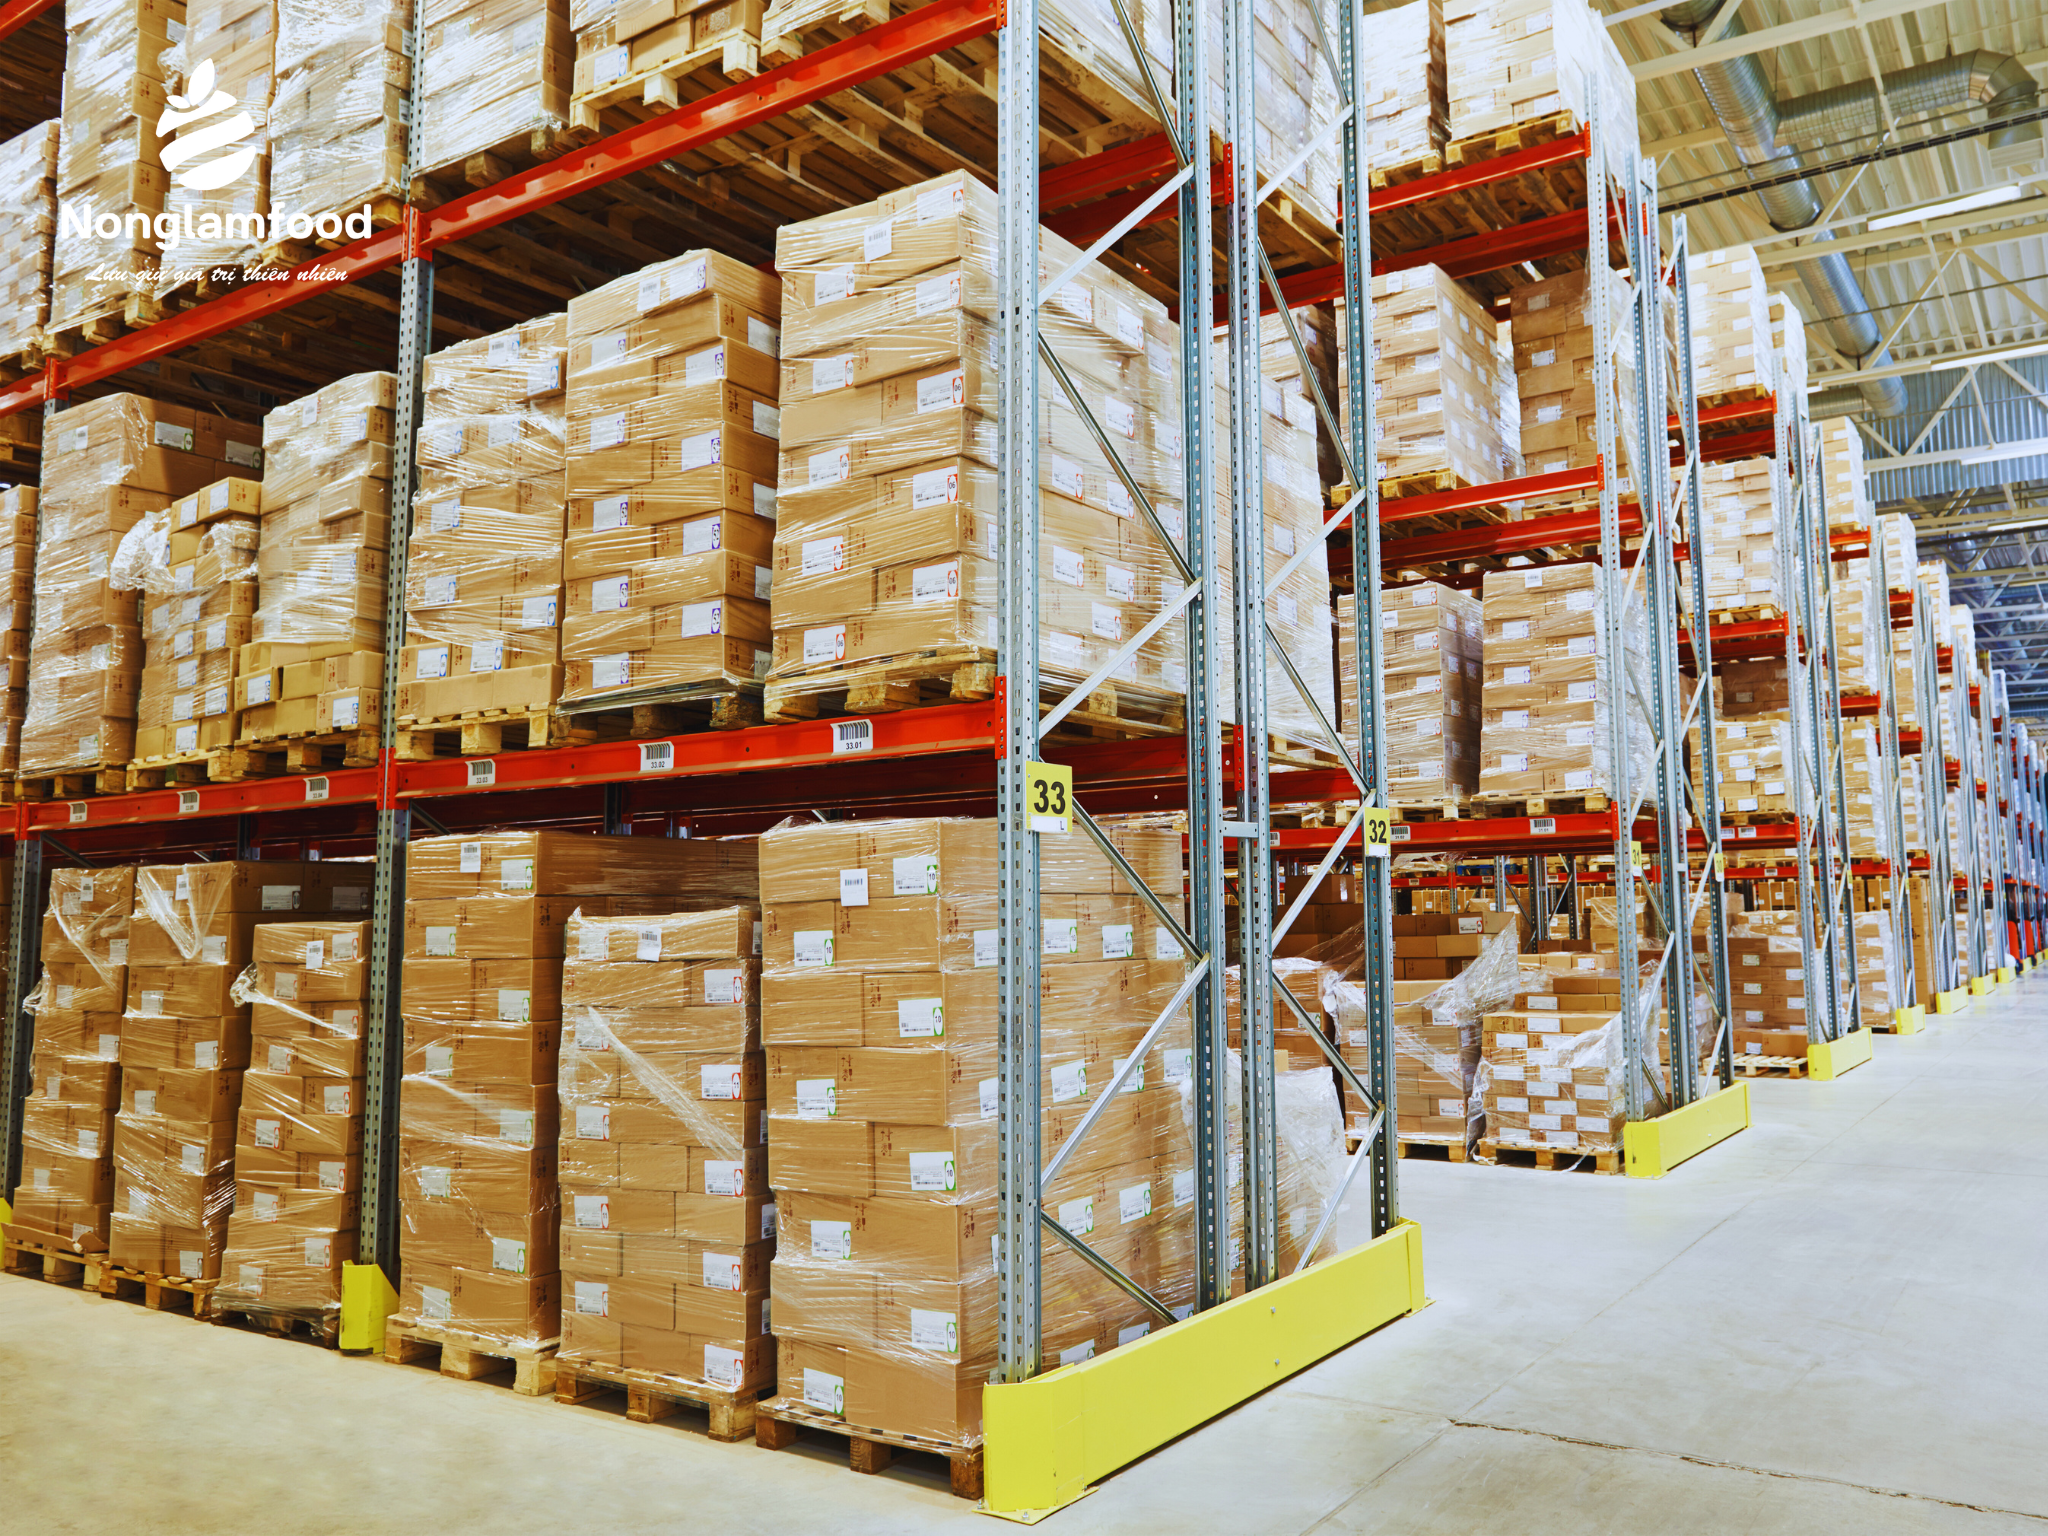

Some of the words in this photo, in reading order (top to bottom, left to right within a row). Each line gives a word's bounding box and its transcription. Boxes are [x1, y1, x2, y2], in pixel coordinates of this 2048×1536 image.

[954, 383, 962, 392] 06
[949, 481, 956, 489] 06
[949, 577, 956, 585] 06
[846, 741, 862, 750] 33.01
[651, 761, 665, 769] 33.02
[1034, 780, 1065, 815] 33
[1060, 821, 1064, 830] L
[1369, 820, 1386, 843] 32
[1633, 849, 1640, 864] 31
[826, 946, 833, 954] 10
[935, 1015, 942, 1023] 10
[946, 1169, 954, 1178] 10
[735, 1178, 742, 1186] 11
[949, 1331, 956, 1339] 10
[836, 1393, 842, 1402] 10
